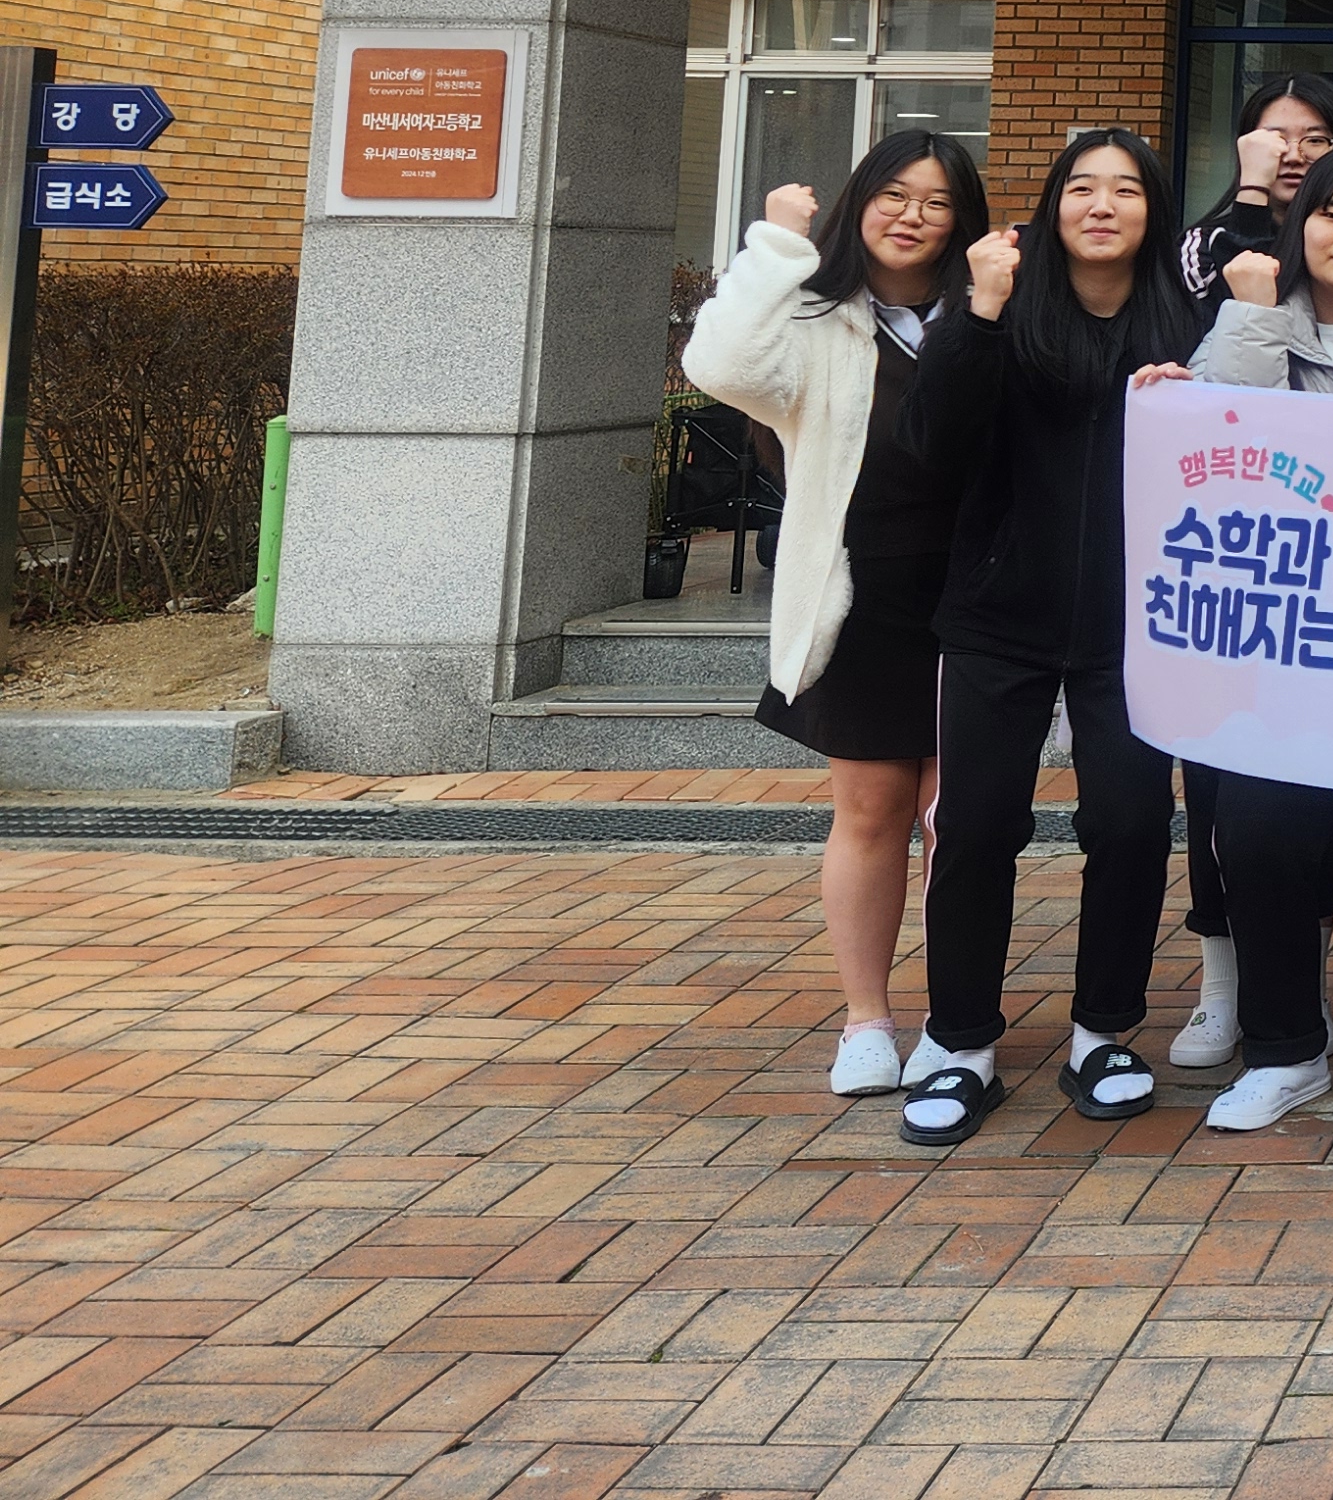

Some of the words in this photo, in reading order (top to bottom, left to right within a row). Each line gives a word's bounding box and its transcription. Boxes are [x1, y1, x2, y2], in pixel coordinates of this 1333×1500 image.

[369, 67, 410, 81] unicef
[368, 87, 380, 96] for
[381, 88, 405, 97] every
[405, 87, 425, 97] child
[362, 112, 483, 132] 마산내서여자고등학교
[362, 147, 478, 162] 유니세프아동친화학교
[46, 182, 132, 210] 급식소
[1162, 506, 1332, 591] 수학과
